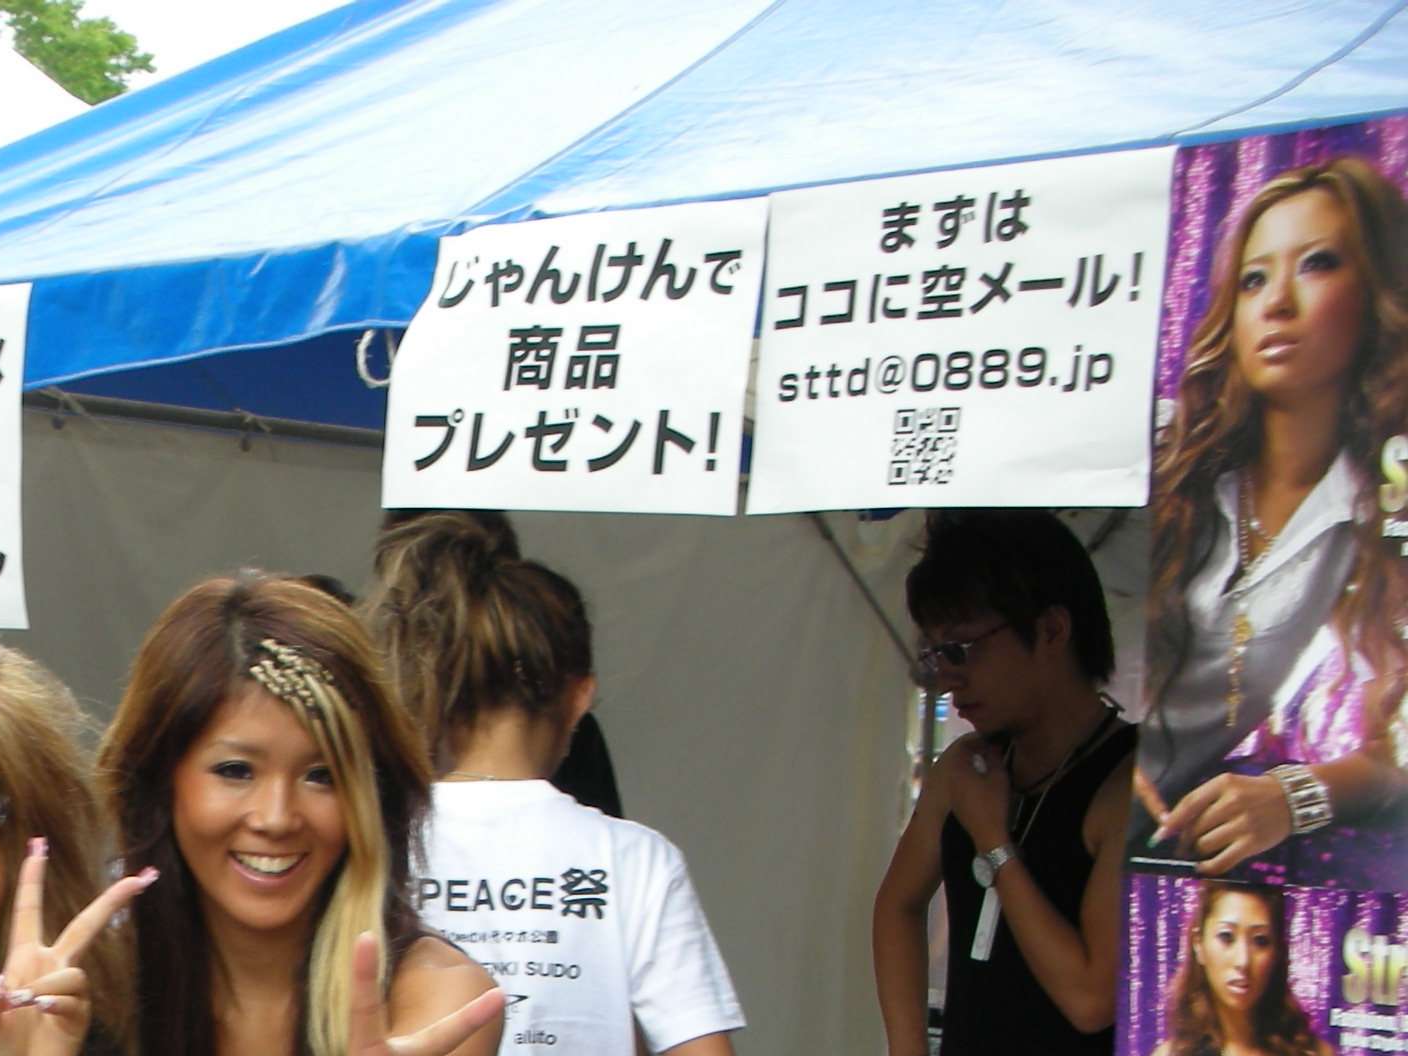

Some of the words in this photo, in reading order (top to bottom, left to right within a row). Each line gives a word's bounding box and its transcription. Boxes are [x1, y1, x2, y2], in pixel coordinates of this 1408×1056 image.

[880, 188, 1032, 255] まずは
[438, 239, 743, 309] じゃんけんで
[773, 252, 1144, 330] ココに空メール！
[503, 324, 621, 391] 商品
[777, 345, 1115, 403] sttd@0889.jp
[413, 408, 720, 476] プレゼント！
[525, 961, 581, 979] SUDO
